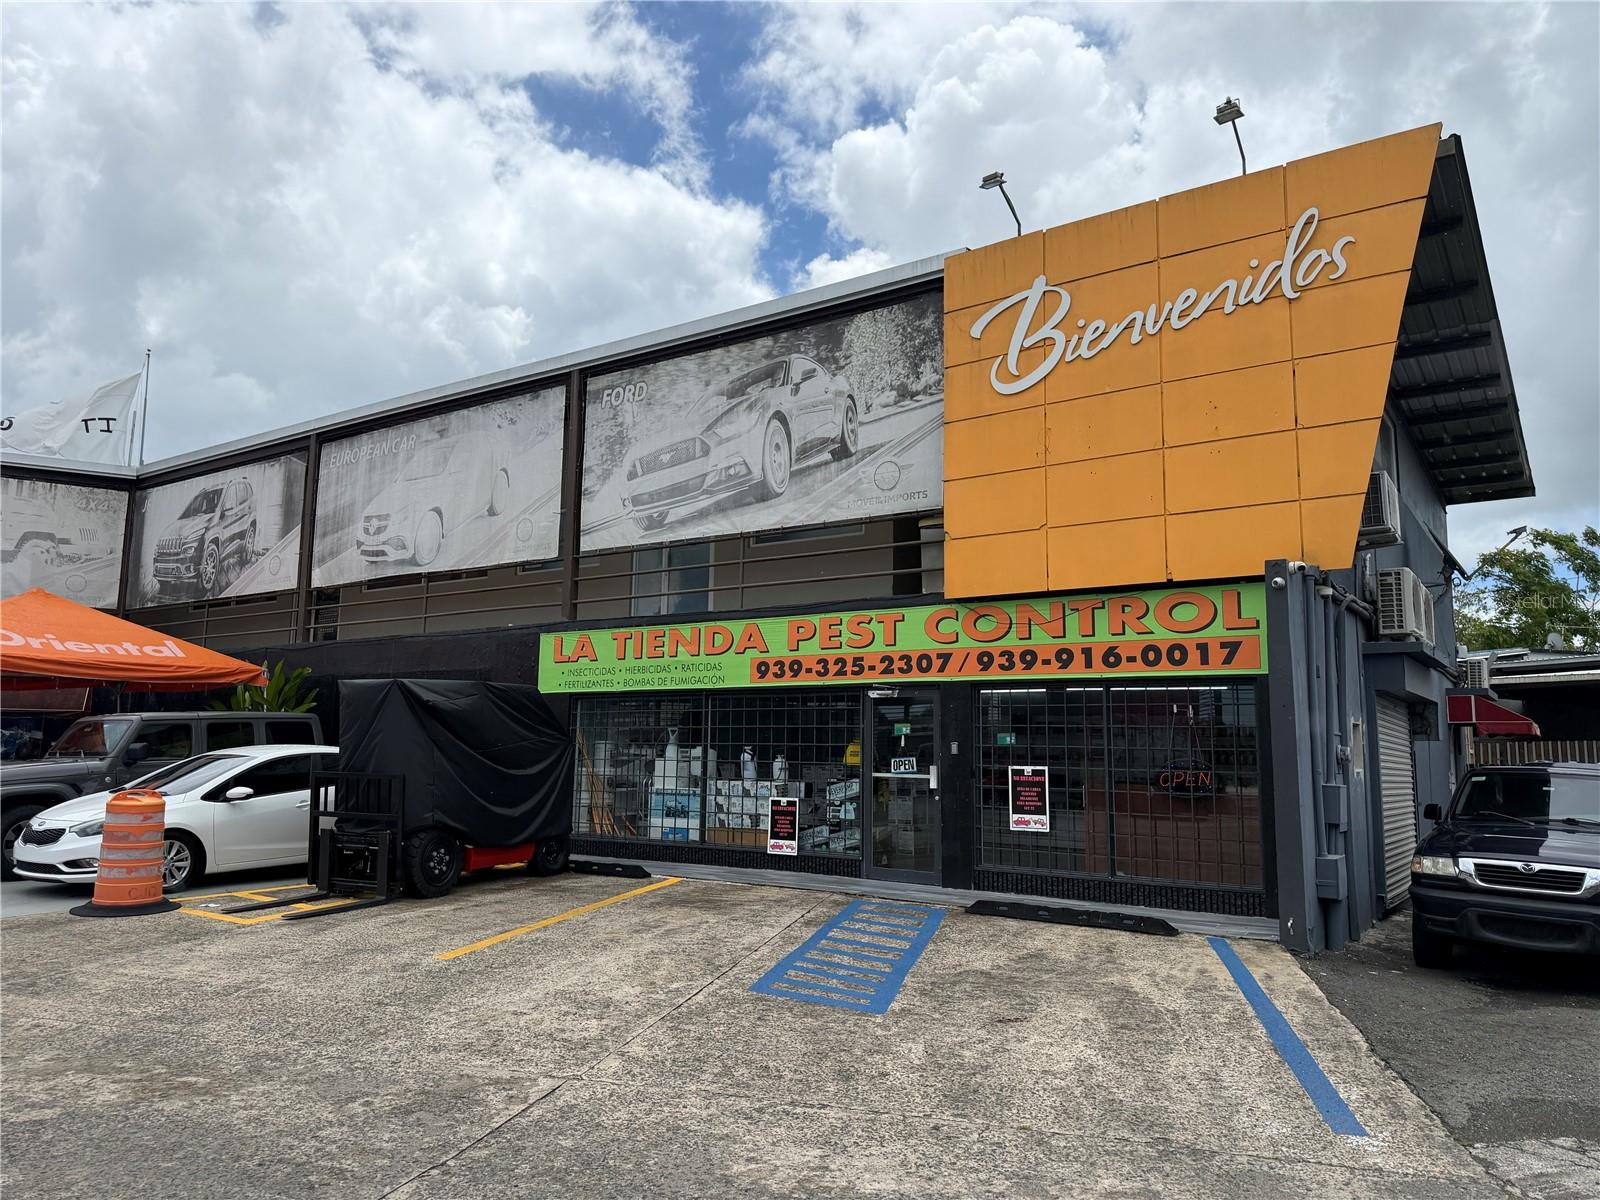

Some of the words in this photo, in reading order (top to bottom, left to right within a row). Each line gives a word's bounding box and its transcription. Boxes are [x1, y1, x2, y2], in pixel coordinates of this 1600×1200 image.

[969, 206, 1357, 396] Bienvenidos
[601, 381, 648, 409] FORD
[330, 438, 390, 468] EUROPEAN
[391, 434, 416, 453] CAR
[553, 633, 598, 663] LA
[612, 623, 769, 659] TIENDA
[787, 613, 904, 651] PEST
[924, 590, 1259, 644] CONTROL
[0, 628, 187, 658] Oriental
[564, 679, 615, 689] FERTILIZANTES
[623, 677, 655, 687] BOMBAS
[657, 676, 668, 686] DE
[669, 673, 725, 685] FUMIGACIÓN
[567, 666, 616, 677] INSECTICIDAS
[624, 664, 672, 675] HIERBICIDAS
[680, 662, 723, 673] RATICIDAS
[893, 759, 915, 771] OPEN
[1159, 770, 1211, 787] OPEN
